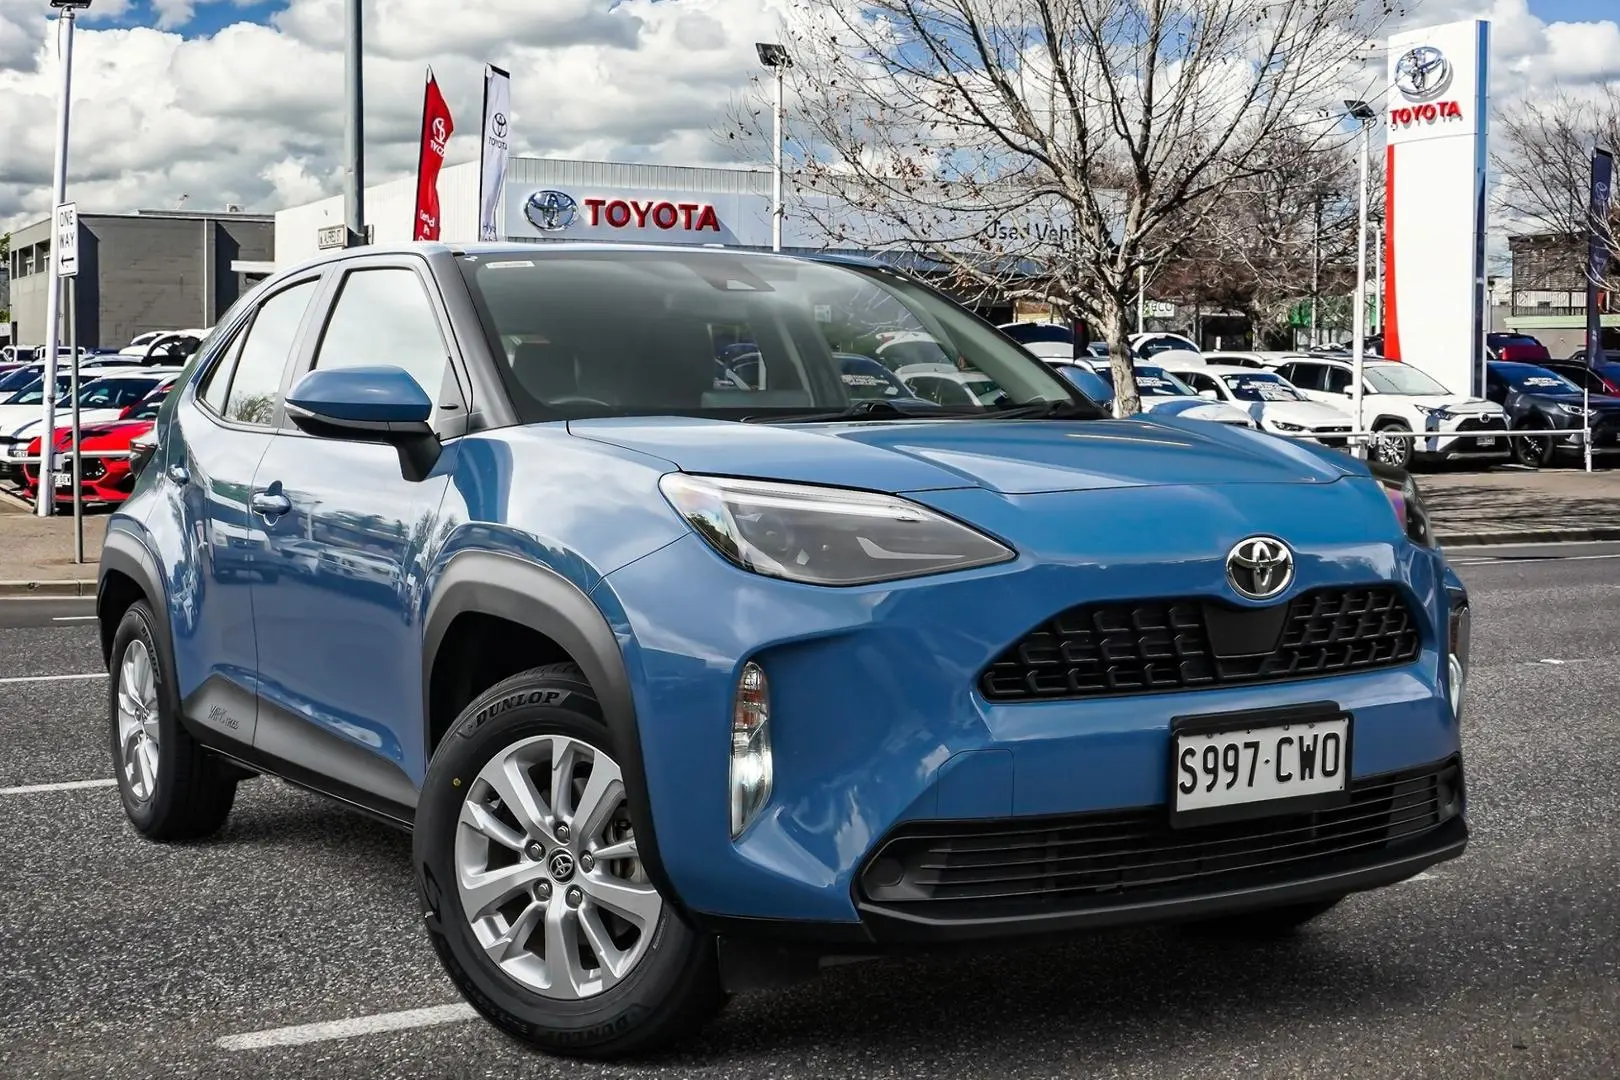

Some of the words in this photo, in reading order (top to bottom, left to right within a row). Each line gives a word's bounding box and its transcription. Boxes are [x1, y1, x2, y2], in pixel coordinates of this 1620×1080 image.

[1390, 101, 1463, 124] TOYOTA
[60, 210, 74, 228] ONE
[584, 199, 720, 232] TOYOTA
[60, 231, 75, 249] WAY
[475, 691, 560, 727] DUNLOP
